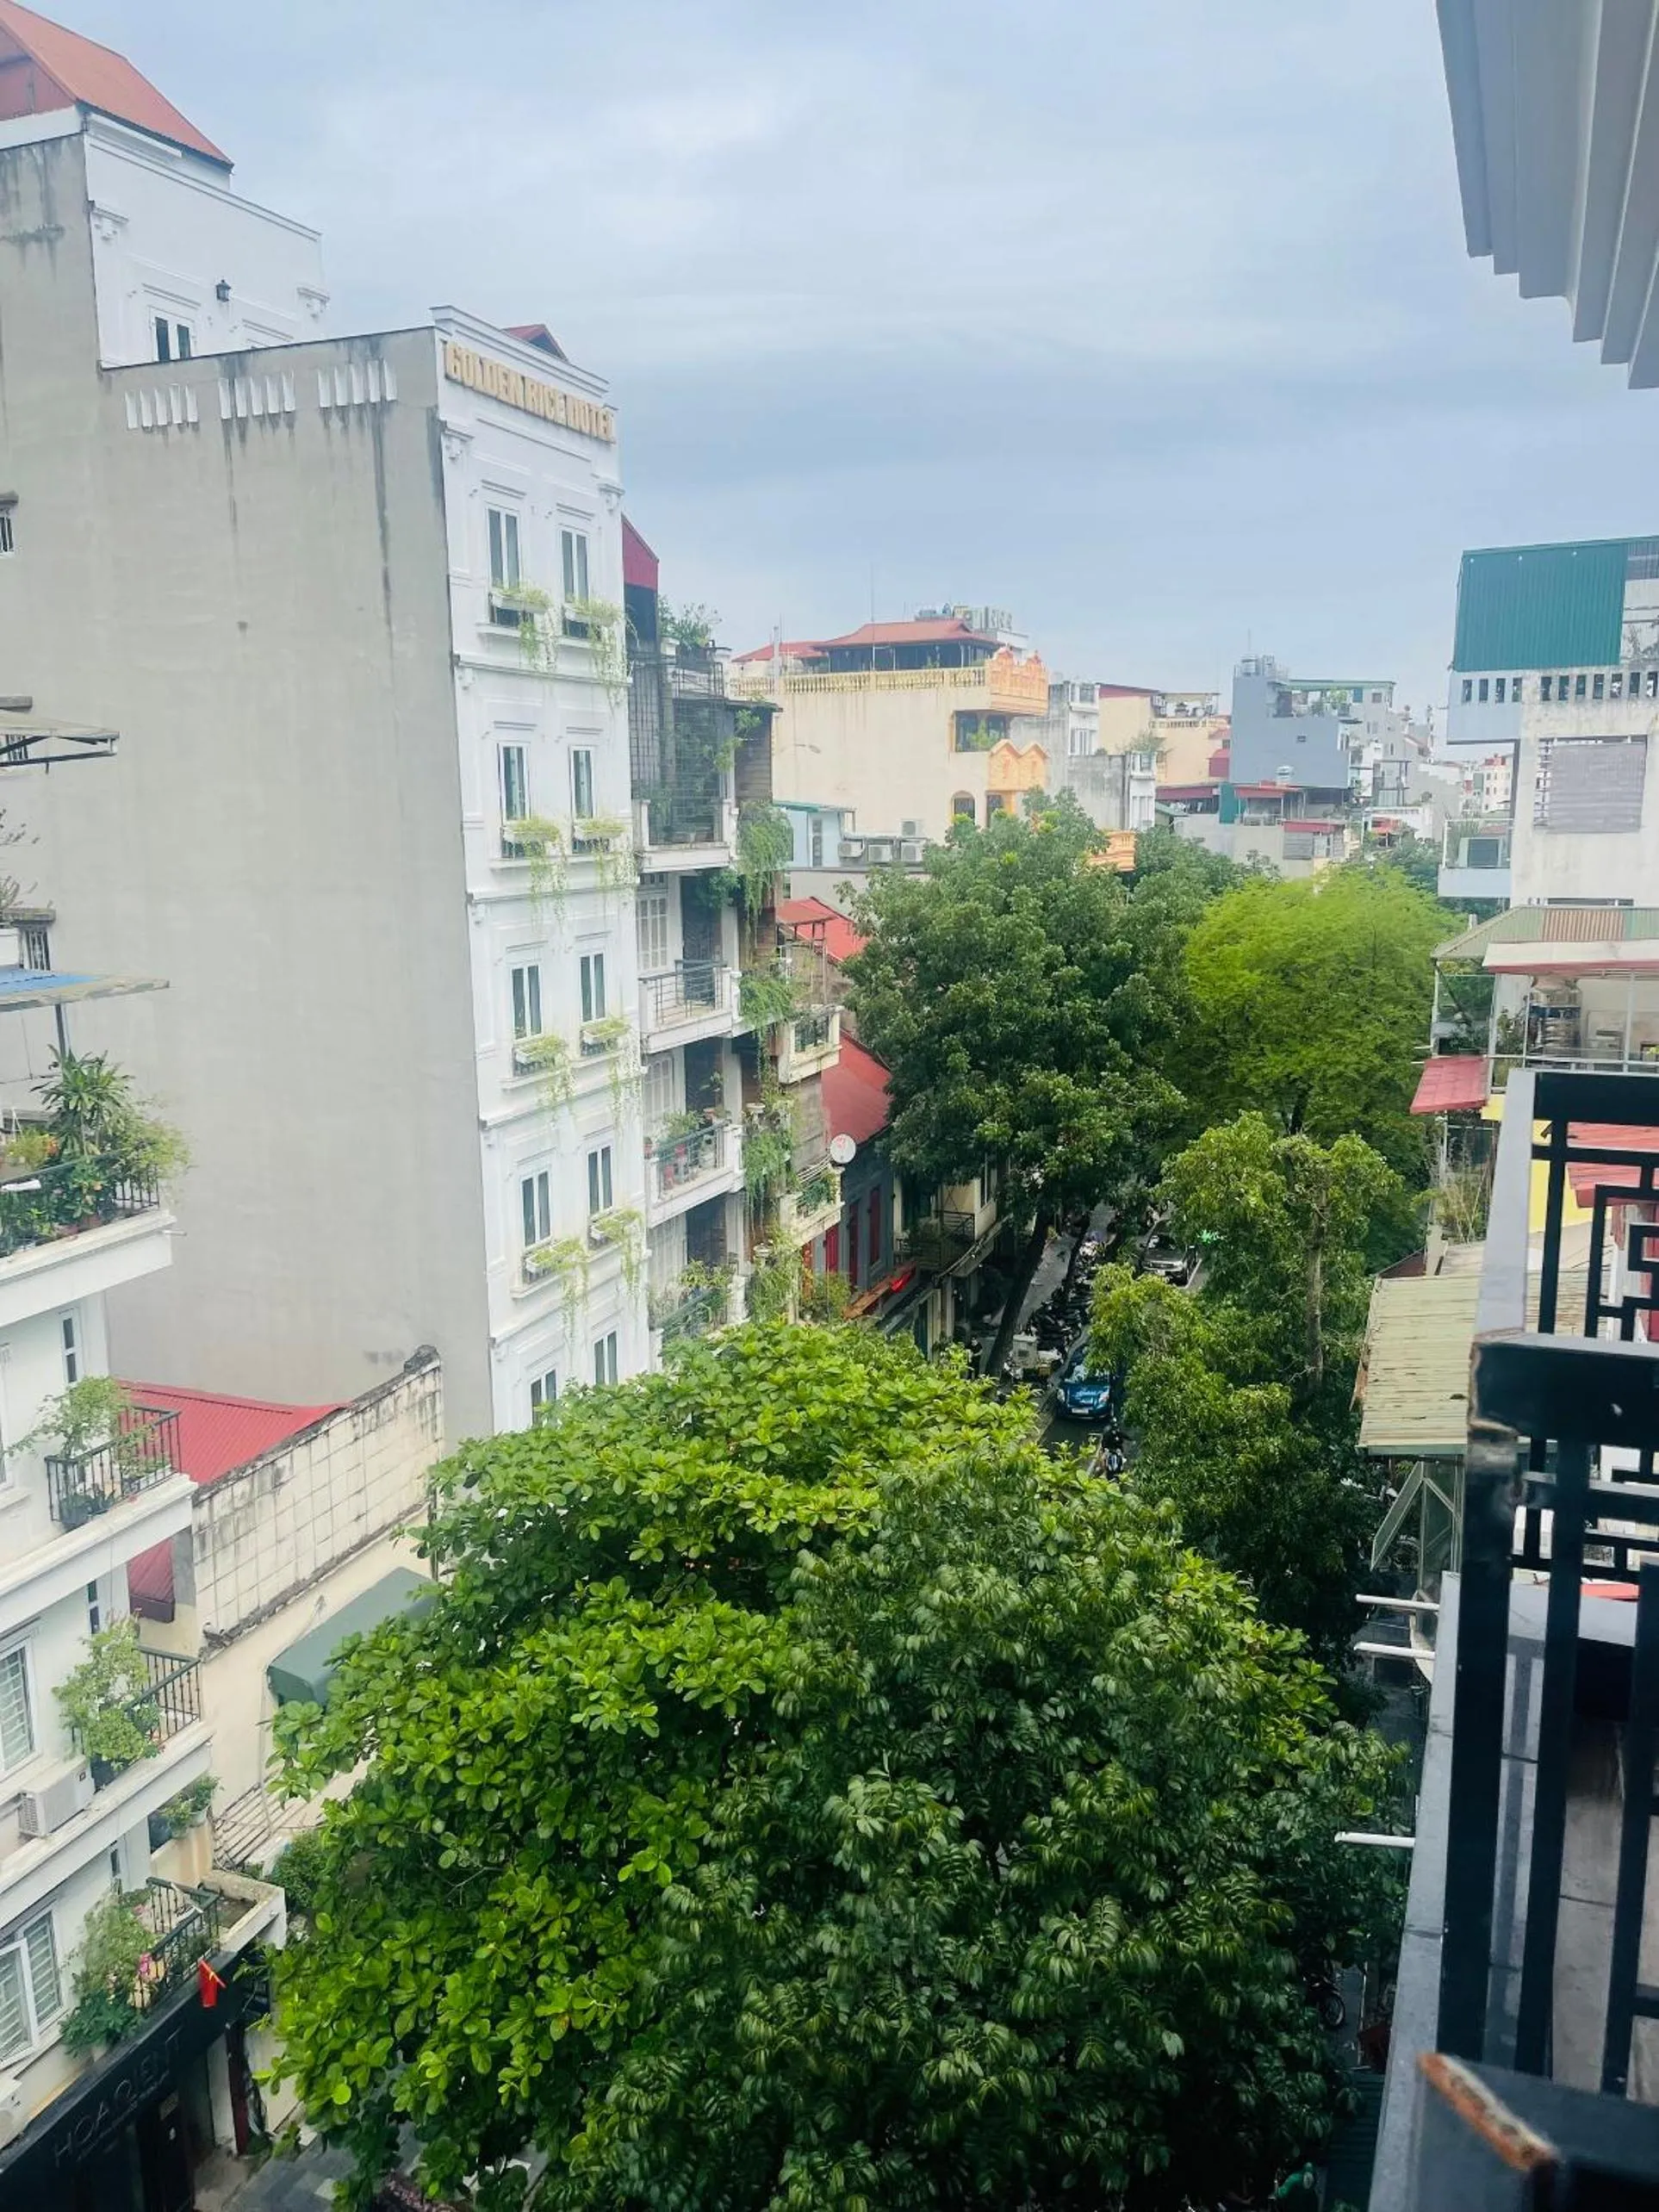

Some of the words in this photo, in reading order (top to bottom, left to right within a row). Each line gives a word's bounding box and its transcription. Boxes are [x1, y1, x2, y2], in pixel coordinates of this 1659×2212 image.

[445, 343, 525, 411] GOLDEN
[525, 376, 567, 426] RICE
[567, 395, 617, 444] HOTEL
